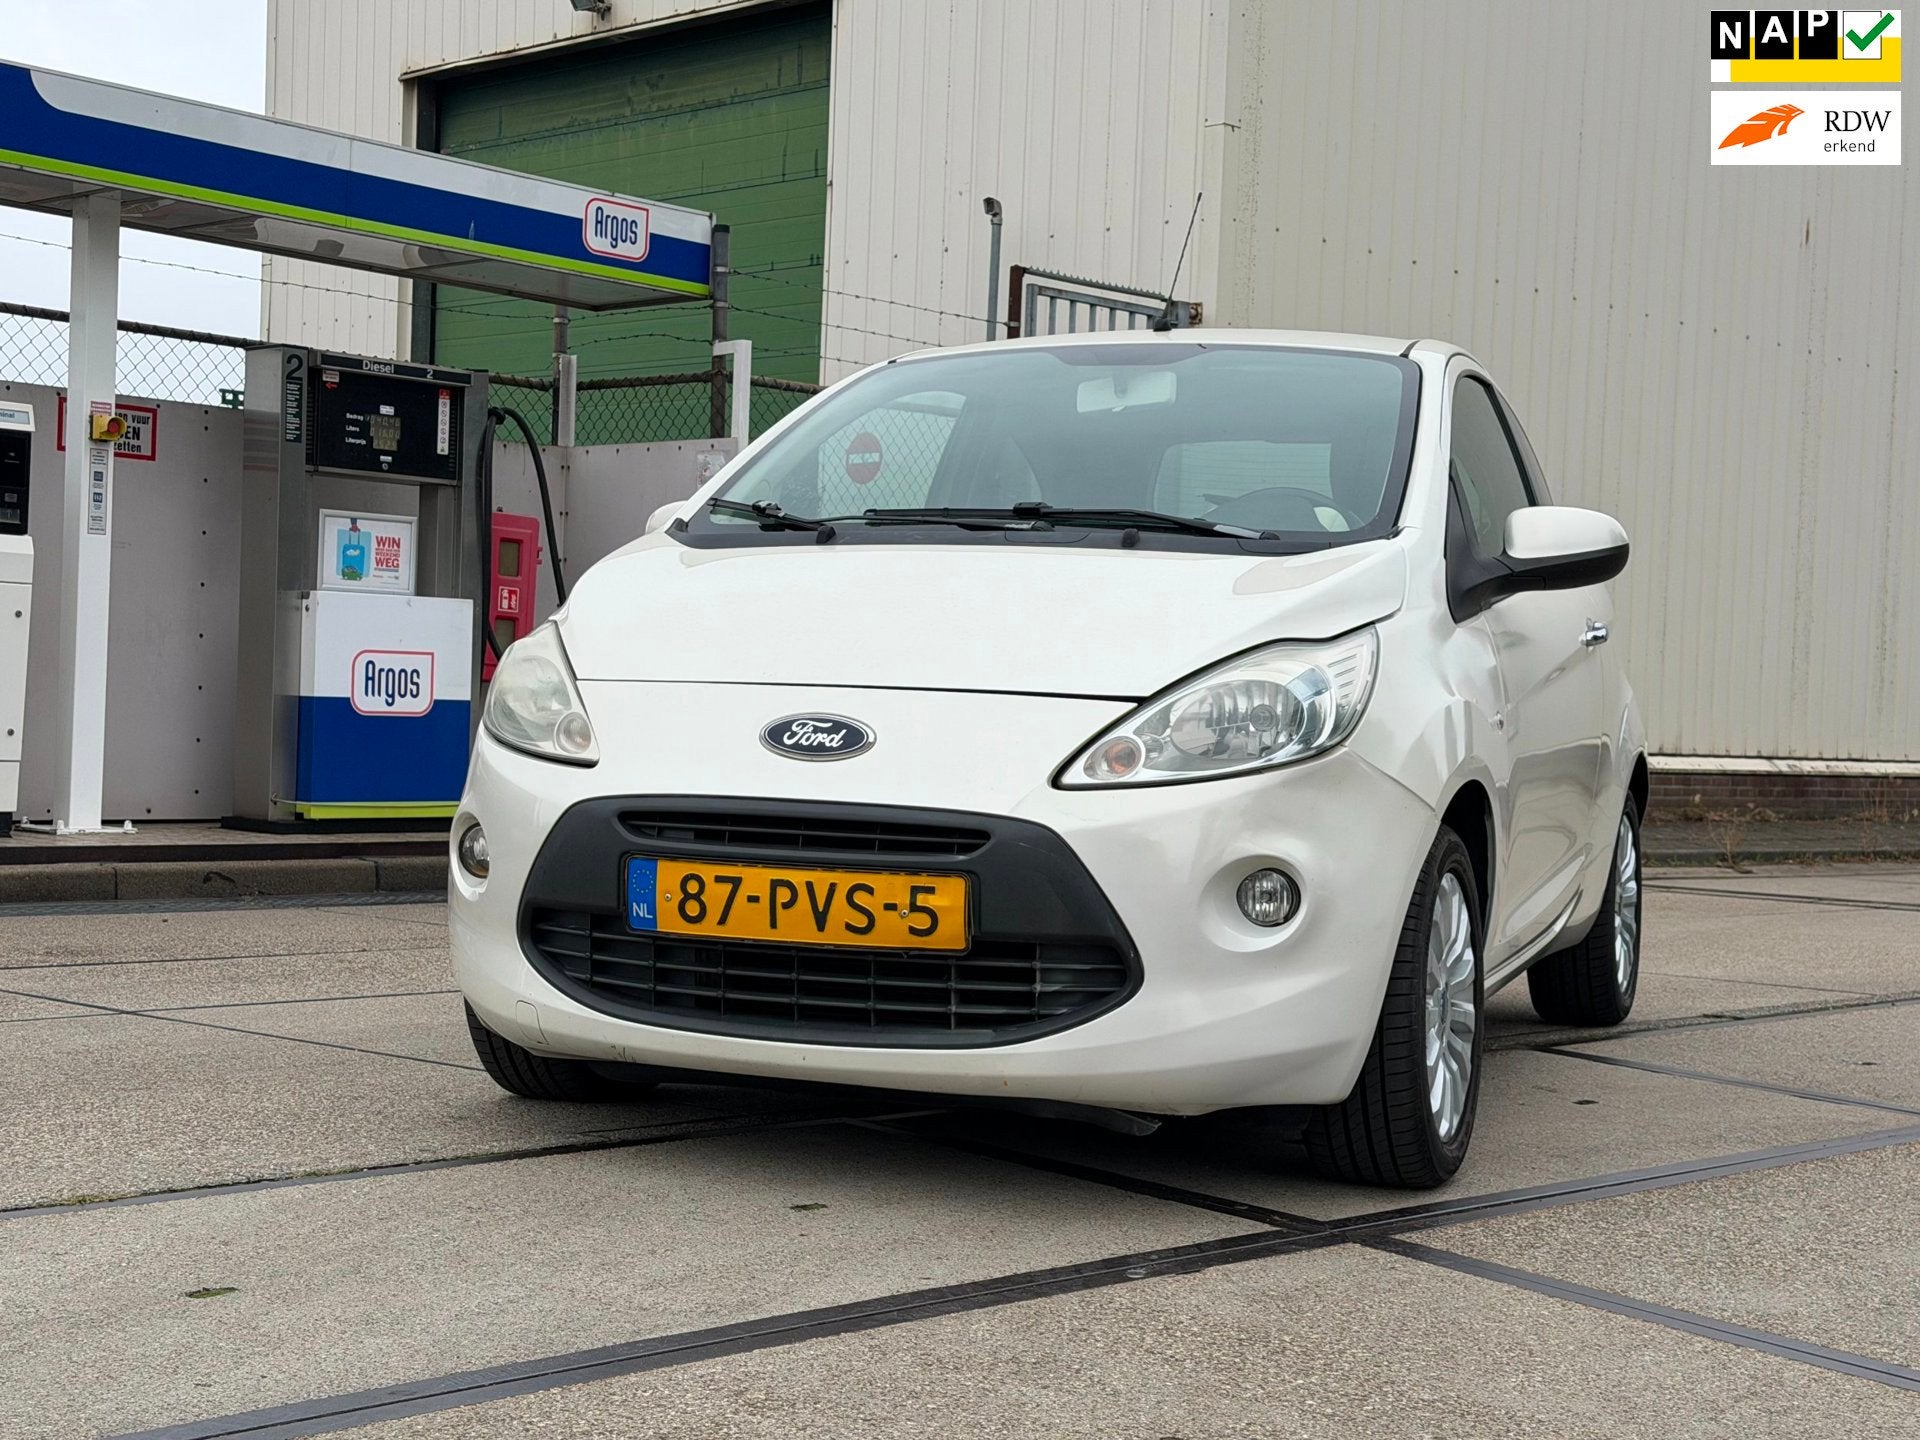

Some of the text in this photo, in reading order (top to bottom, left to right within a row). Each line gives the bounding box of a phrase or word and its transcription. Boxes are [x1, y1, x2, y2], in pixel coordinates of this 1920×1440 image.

[594, 206, 638, 249] Argos
[286, 354, 303, 380] 2
[363, 360, 433, 379] Diesel 2
[132, 414, 151, 425] vuur
[375, 535, 400, 549] WIN
[375, 557, 400, 568] WEG
[364, 660, 420, 707] Argos
[783, 720, 847, 748] Ford
[632, 902, 653, 919] NL
[678, 873, 939, 938] 87-PVS-5
